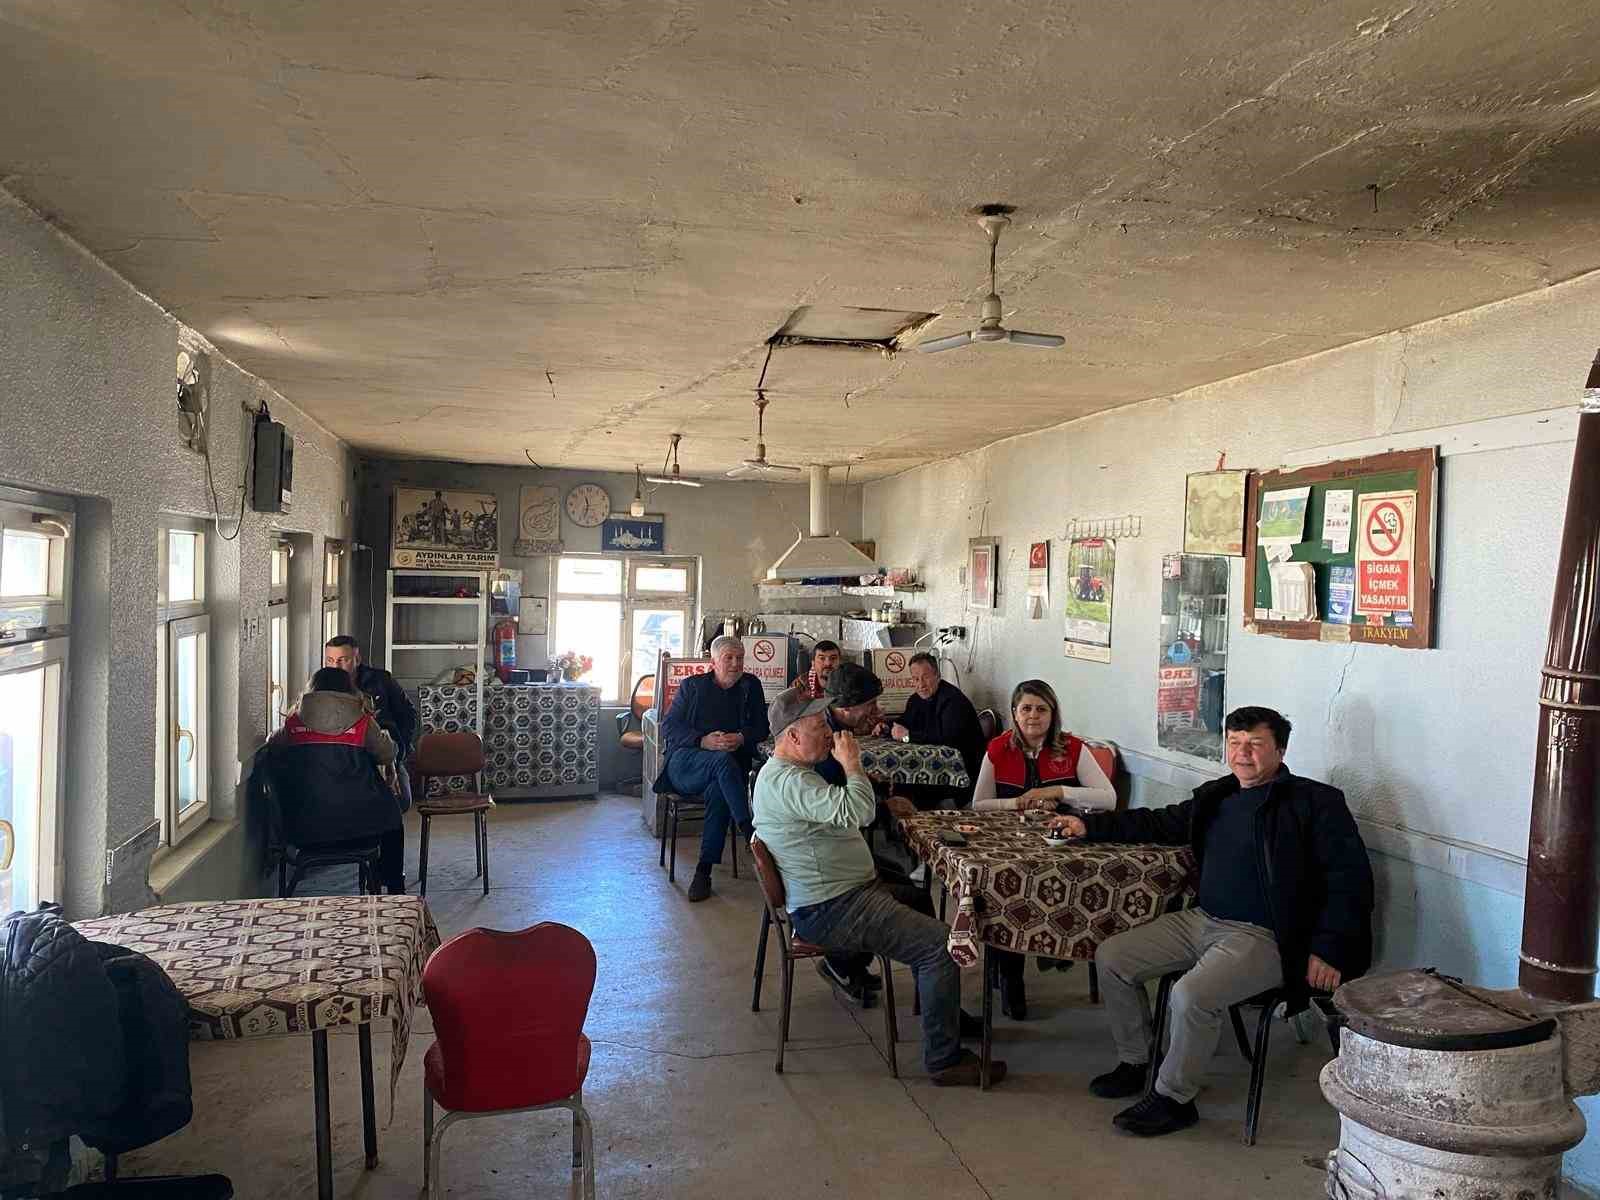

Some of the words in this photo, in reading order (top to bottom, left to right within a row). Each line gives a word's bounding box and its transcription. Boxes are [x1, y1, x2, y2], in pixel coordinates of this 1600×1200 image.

[415, 551, 463, 561] AYDINLAR
[466, 553, 495, 561] TARIM
[1367, 562, 1401, 576] SİGARA
[1369, 577, 1399, 592] İÇMEK
[1361, 594, 1408, 606] YASAKTIR
